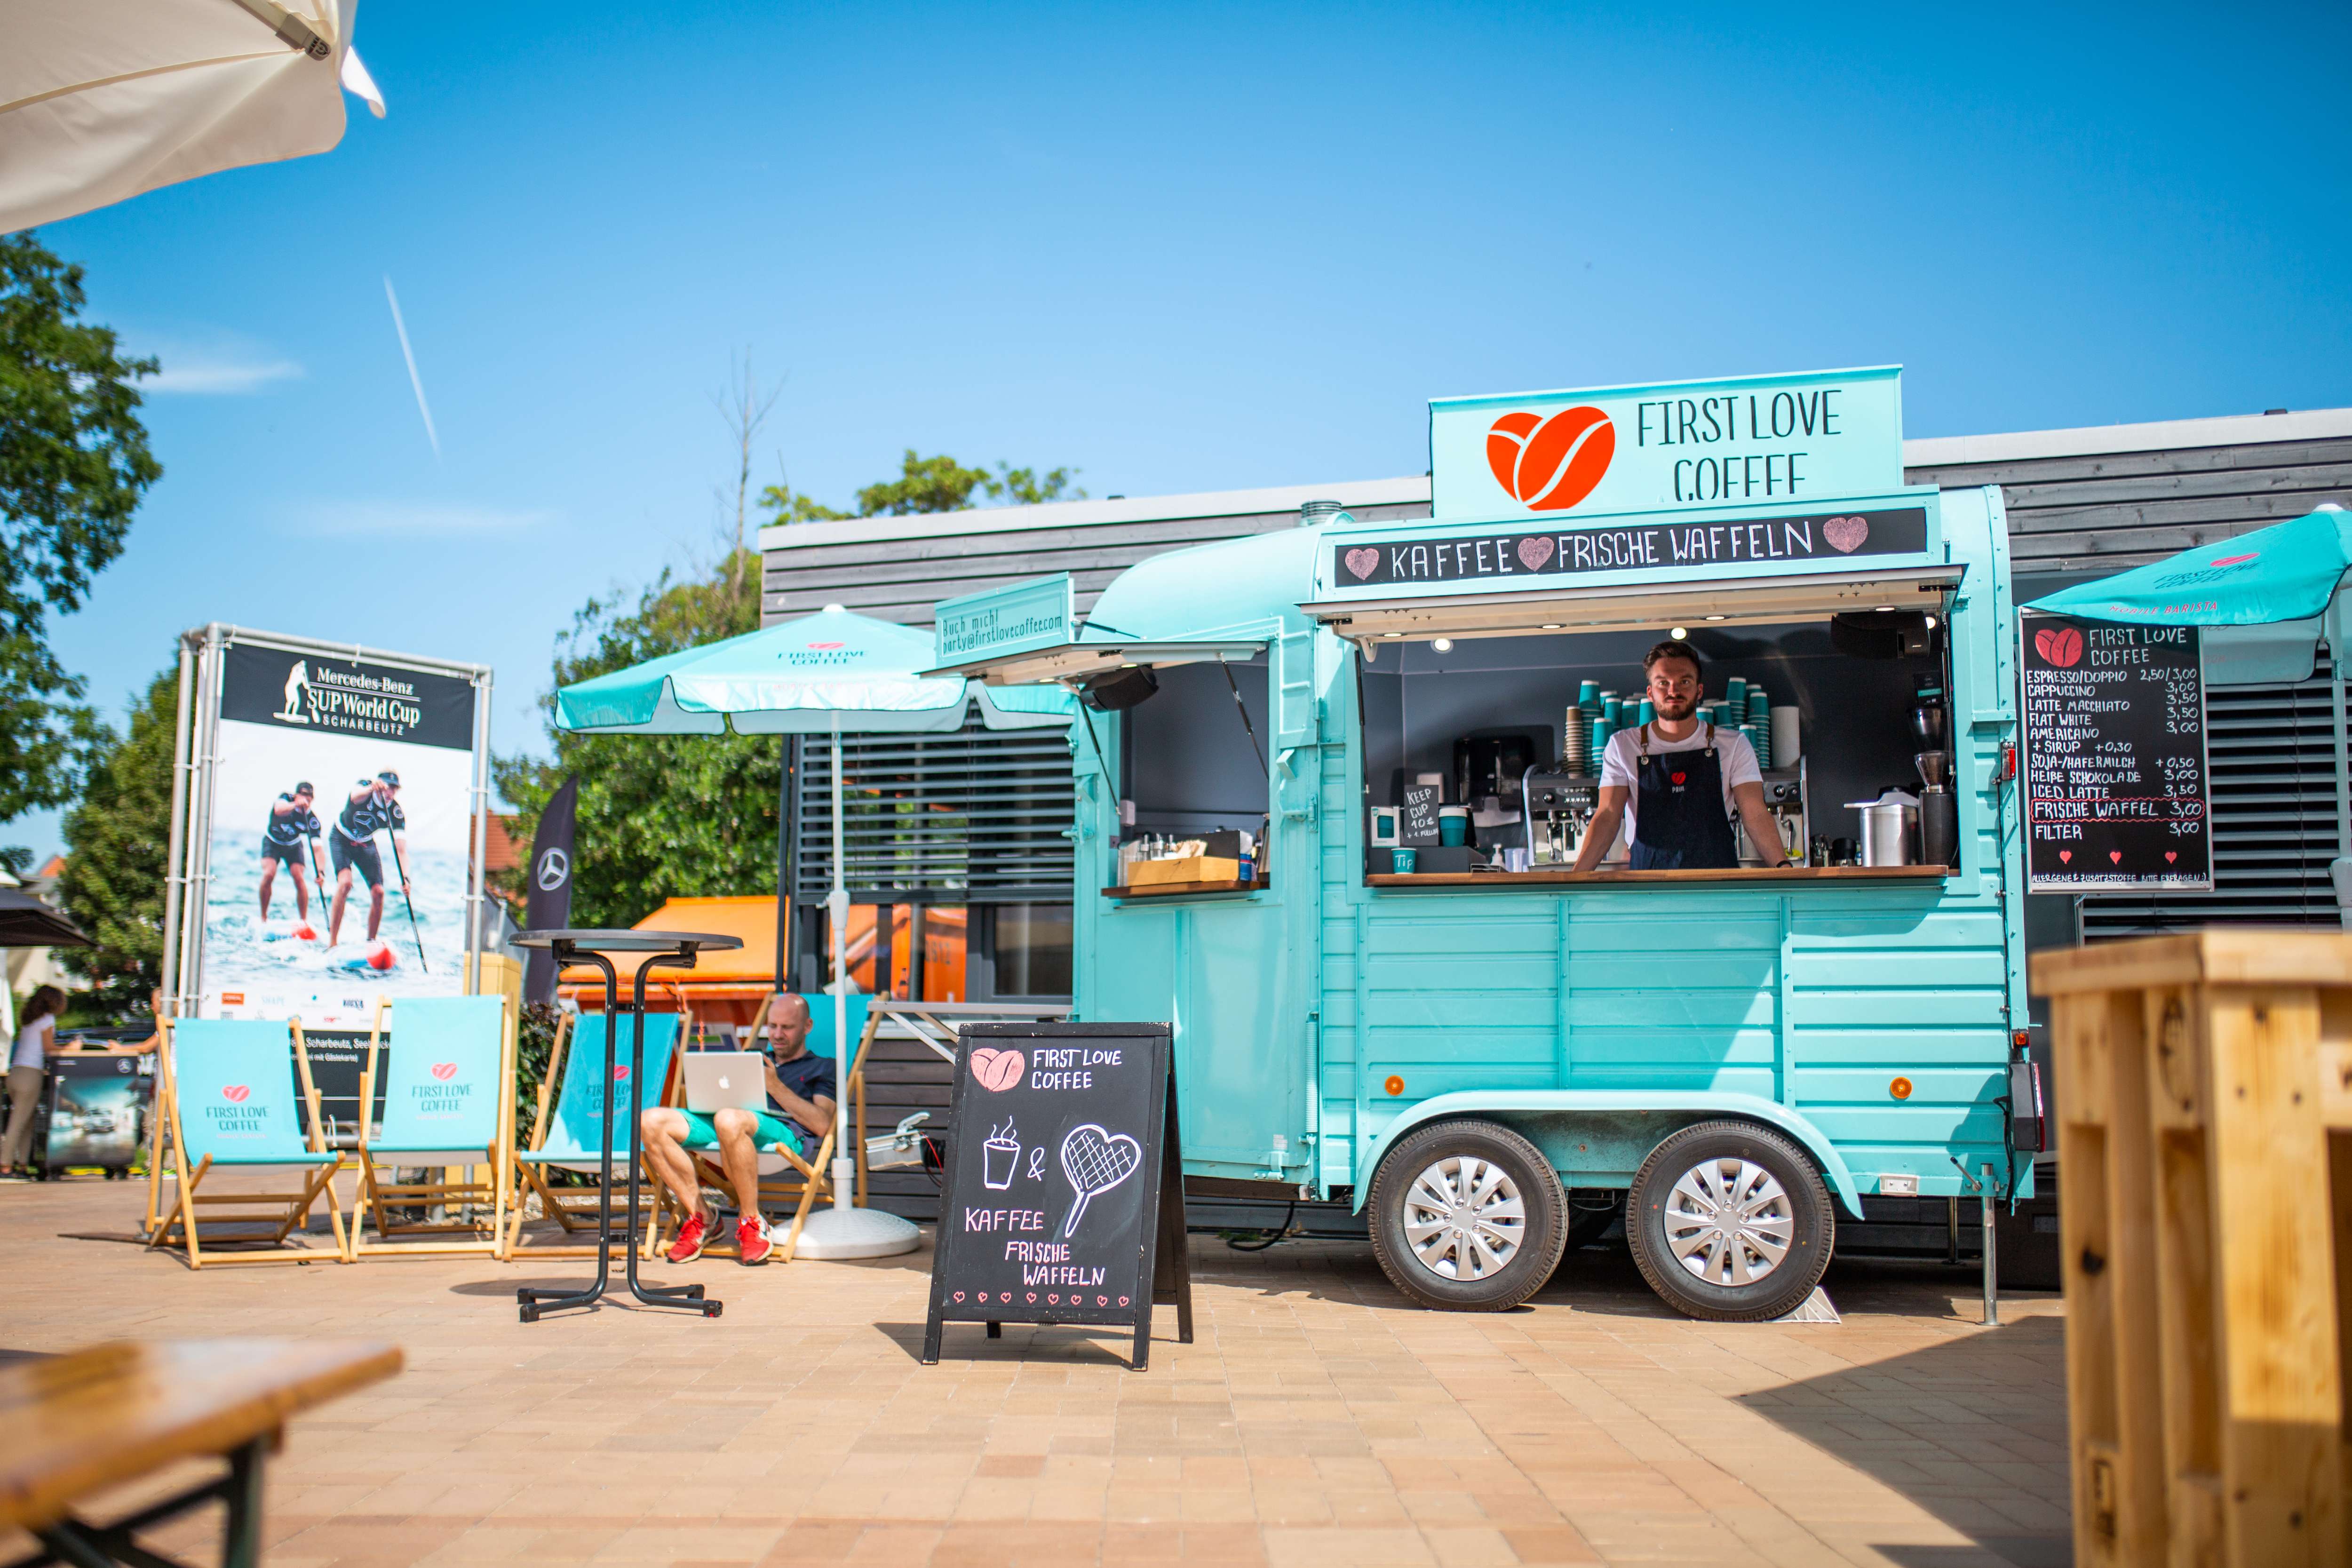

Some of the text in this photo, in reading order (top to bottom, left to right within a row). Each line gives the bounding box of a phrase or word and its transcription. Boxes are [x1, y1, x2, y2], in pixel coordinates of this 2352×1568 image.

[1638, 390, 1841, 446] FIRST LOVE
[1391, 521, 1812, 577] KAFFEE FRISCHE WAFFELN
[2109, 600, 2217, 614] MOBILE BARISTA
[943, 609, 998, 637] Buch mich!
[943, 616, 1062, 654] party@firstlovecoffee.com
[2090, 628, 2187, 647] FIRST LOVE
[2091, 649, 2149, 666] COFFEE
[317, 667, 414, 695] Mercedes-Benz
[2026, 670, 2127, 684] ESPRESSO/DOPPIO
[2027, 682, 2195, 697] CAPPUCCINO 3,00
[307, 688, 421, 728] SUP World Cup
[2028, 692, 2197, 712] LATTE MACCHIATO 3,50
[323, 714, 405, 736] SCHARBEUTZ
[2029, 707, 2198, 726] FLAT WHITE 3,50
[2030, 721, 2198, 740] AMERICANO 3,00
[2044, 740, 2081, 753] SIRUP
[2069, 771, 2141, 785] SCHOKOLADE
[2164, 769, 2198, 781] 3,00
[1406, 788, 1431, 805] KEEP
[2033, 784, 2197, 799] ICED LATTE 3,50
[1409, 804, 1428, 819] CUP
[2034, 802, 2201, 819] FRISCHE WAFFEL 3,00
[2035, 822, 2199, 840] FILTER 3,00
[1395, 854, 1413, 870] Tip
[1033, 1049, 1122, 1067] FIRST LOVE
[1032, 1071, 1092, 1090] COFFEE
[412, 1083, 473, 1098] FIRST LOVE
[206, 1106, 270, 1118] FIRST LOVE
[421, 1098, 462, 1112] COFFEE
[218, 1120, 262, 1131] COFFEE
[1027, 1146, 1046, 1181] &
[965, 1207, 1044, 1232] KAFFEE
[1005, 1241, 1070, 1264] FRISCHE
[1024, 1264, 1105, 1286] WAFFELN
